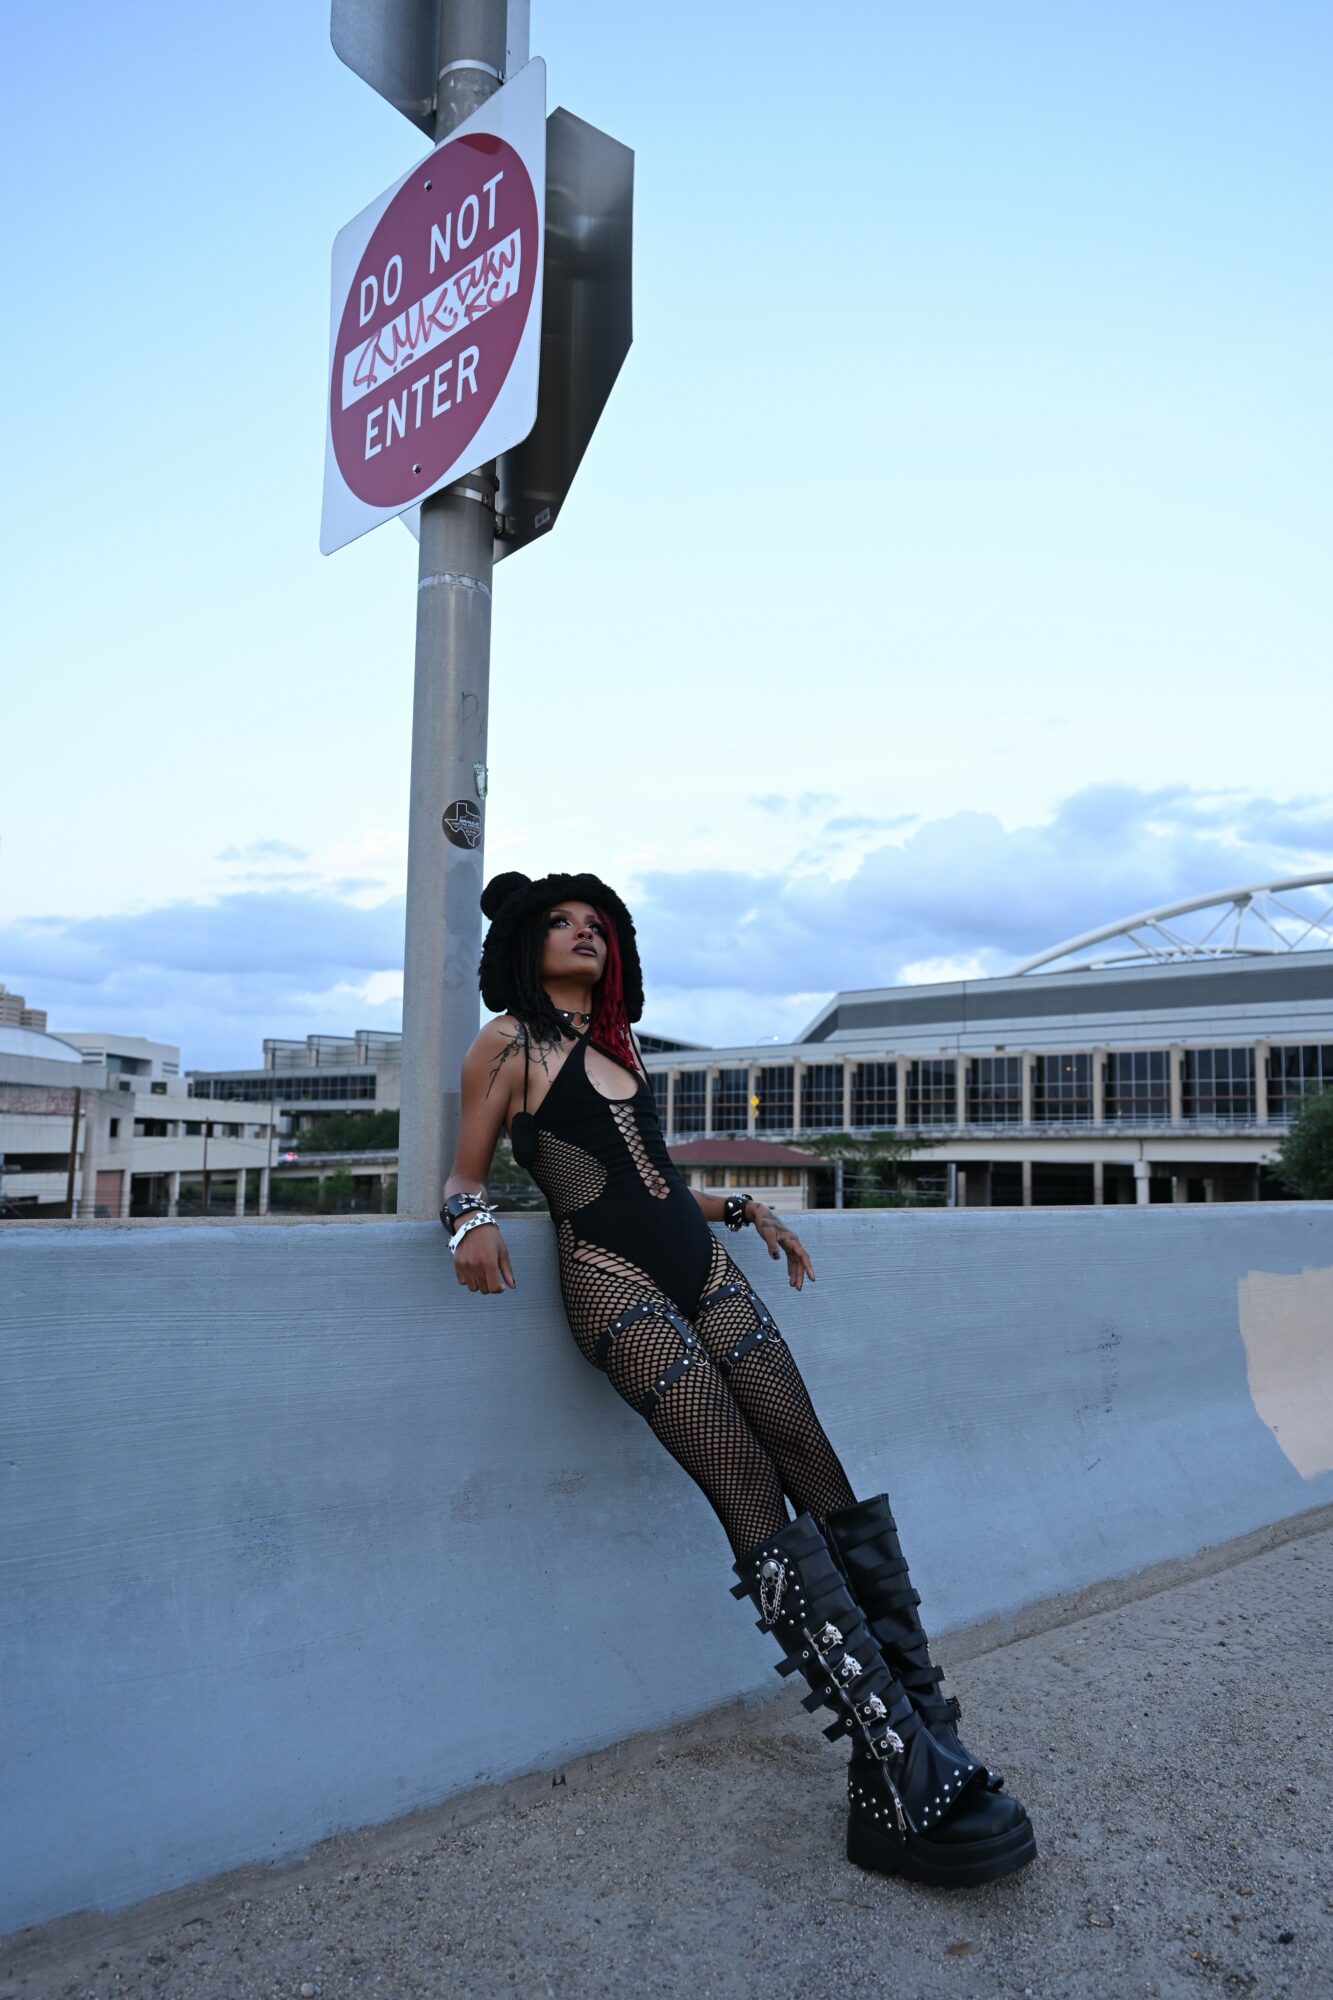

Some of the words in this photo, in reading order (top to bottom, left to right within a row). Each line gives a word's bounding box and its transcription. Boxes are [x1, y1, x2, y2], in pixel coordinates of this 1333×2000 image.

[359, 254, 403, 328] DO
[429, 170, 504, 275] NOT
[364, 344, 480, 461] ENTER
